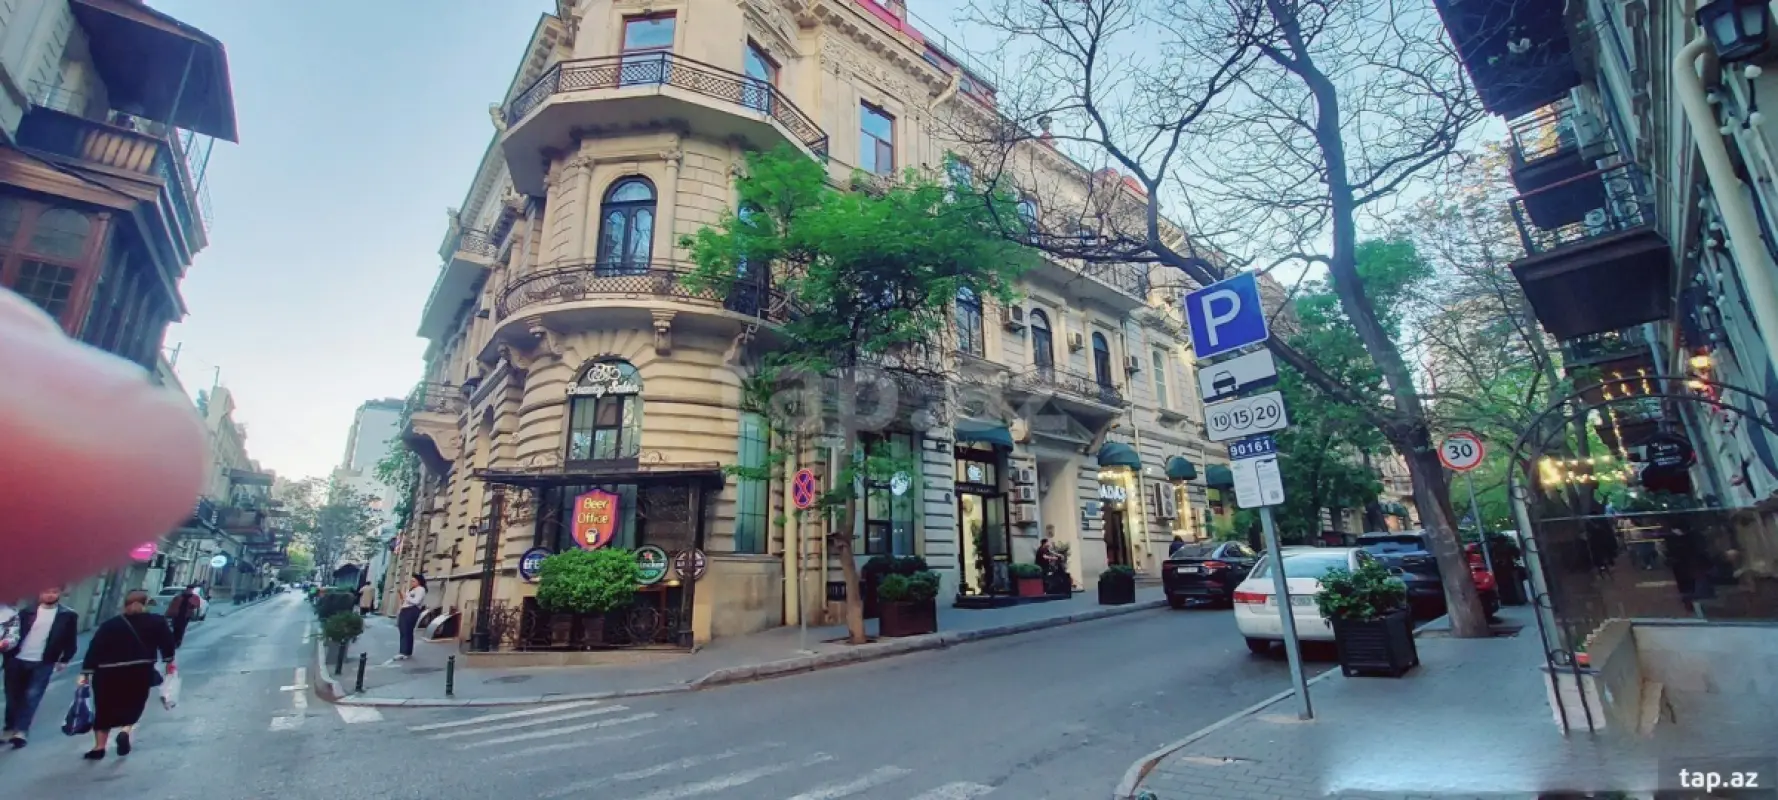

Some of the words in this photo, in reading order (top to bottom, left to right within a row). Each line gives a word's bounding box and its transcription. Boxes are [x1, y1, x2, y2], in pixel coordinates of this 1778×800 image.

[1201, 289, 1240, 347] P
[1213, 414, 1227, 427] 10
[1233, 410, 1249, 424] 15
[1255, 404, 1276, 420] 20
[1230, 440, 1270, 456] 90161
[1449, 443, 1473, 460] 30
[583, 497, 609, 510] Beer
[577, 511, 609, 524] Office
